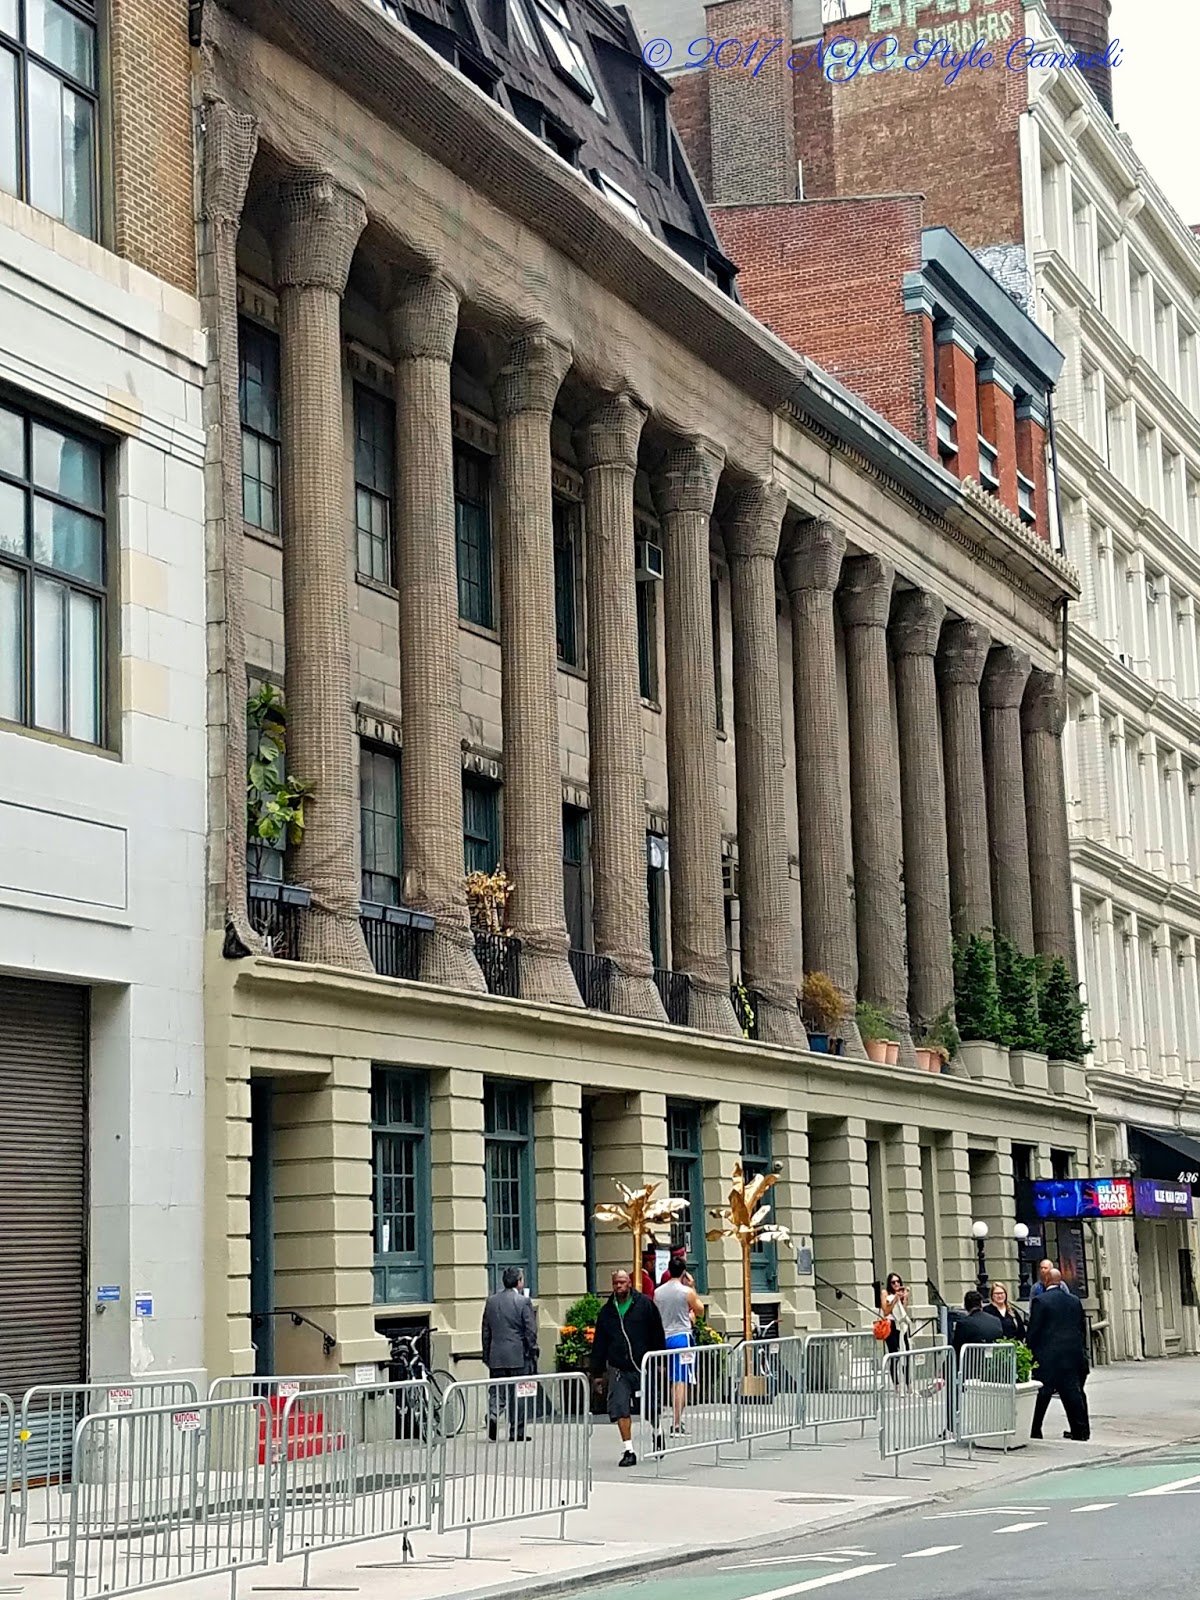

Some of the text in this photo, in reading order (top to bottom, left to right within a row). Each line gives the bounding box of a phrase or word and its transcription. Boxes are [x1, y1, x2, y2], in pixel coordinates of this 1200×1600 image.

[1177, 1171, 1199, 1183] 436
[1097, 1184, 1127, 1194] BLUE
[1098, 1194, 1128, 1203] MAN
[1098, 1202, 1129, 1211] GROUP
[110, 1389, 132, 1397] NATIONAL
[174, 1413, 199, 1423] NATIONAL
